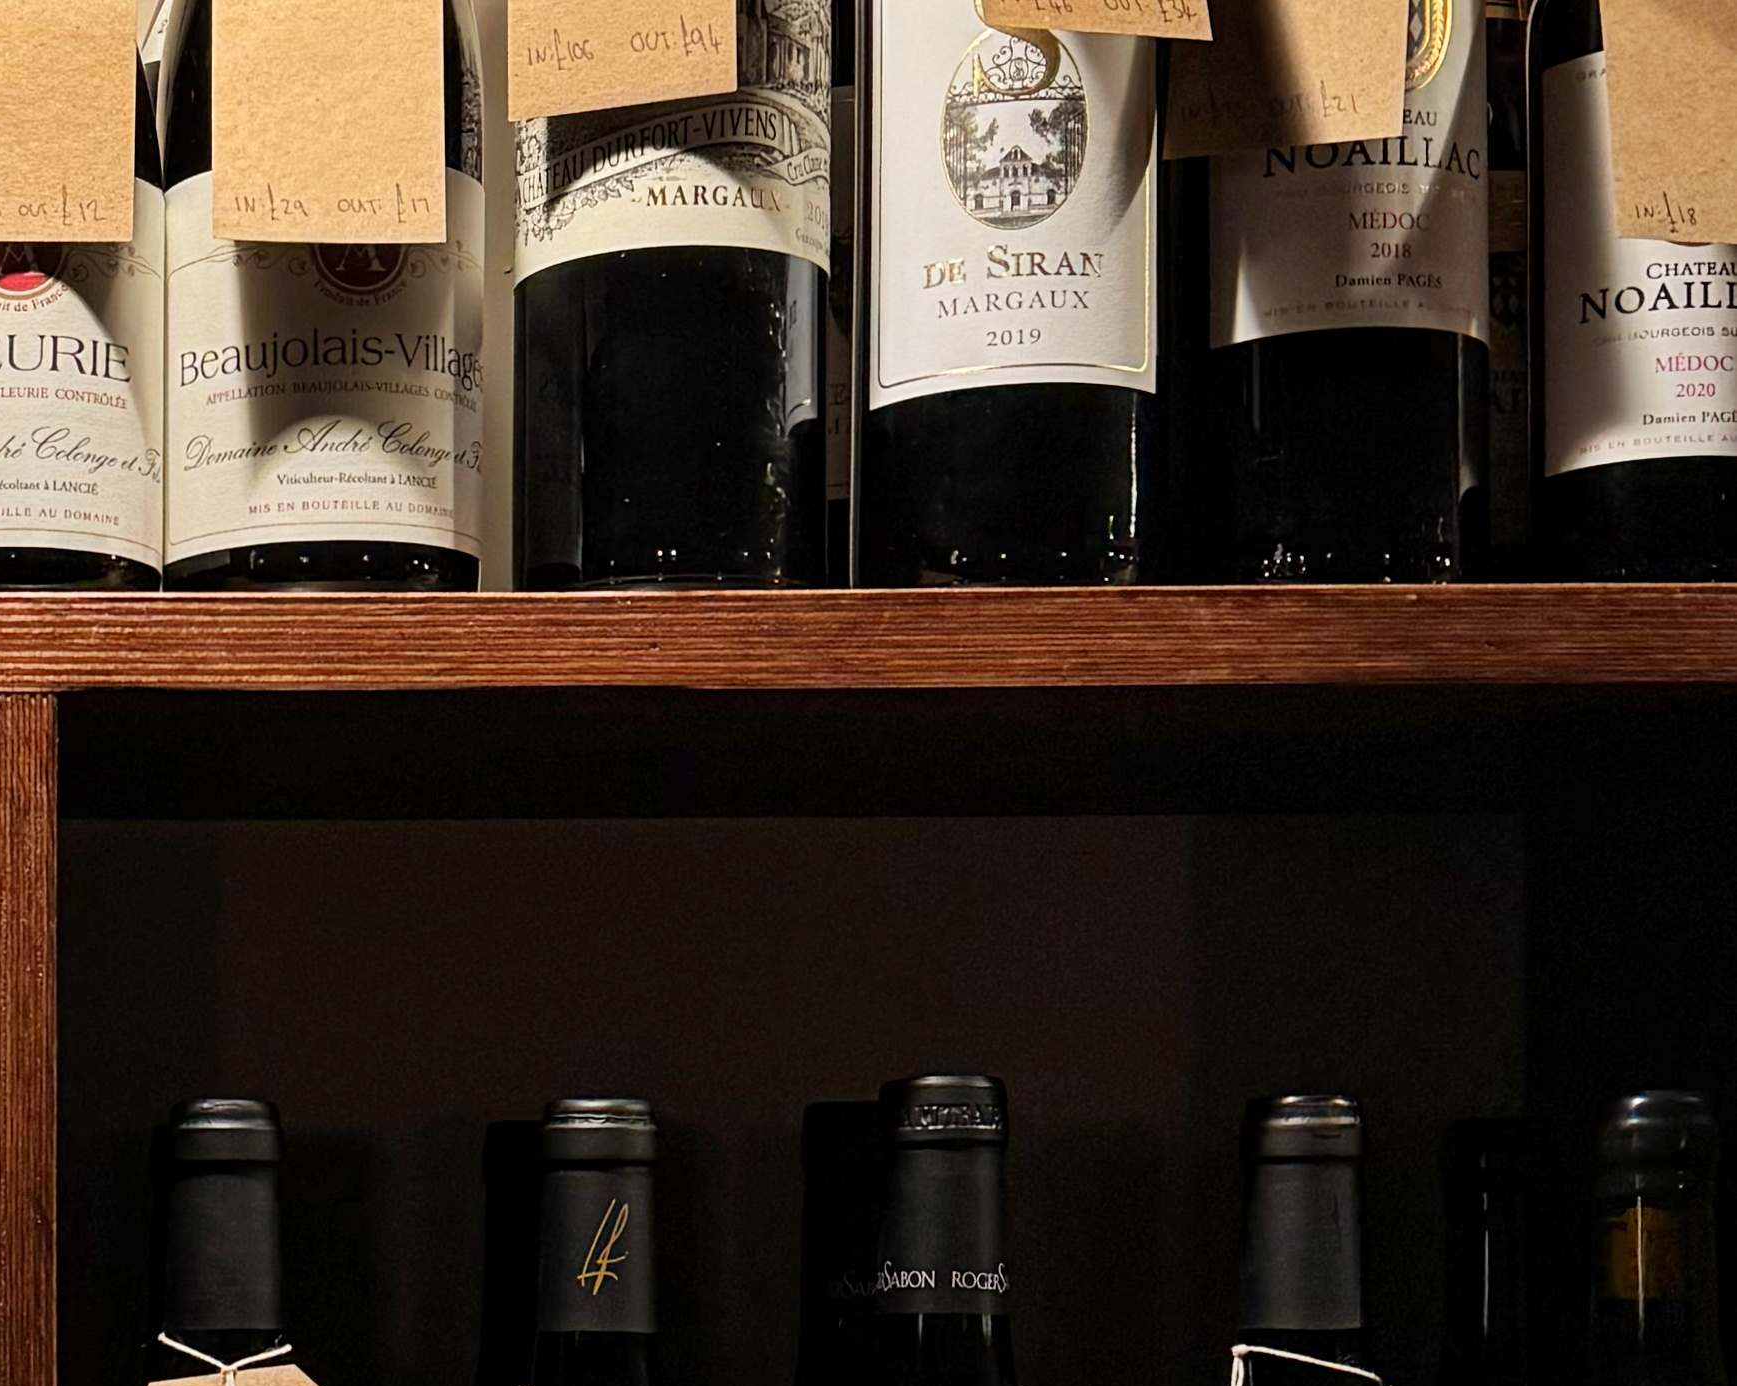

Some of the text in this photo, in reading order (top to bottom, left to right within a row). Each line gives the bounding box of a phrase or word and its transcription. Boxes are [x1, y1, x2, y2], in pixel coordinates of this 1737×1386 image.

[593, 108, 778, 175] DURFORT-VIVENS
[1262, 136, 1482, 180] NOAILLAC
[646, 184, 781, 213] MARGAUX
[1348, 206, 1431, 232] MÉDOC
[1370, 241, 1412, 260] 2018
[923, 244, 1104, 289] DE SIRAN
[1335, 273, 1391, 289] Damien
[32, 283, 70, 311] France
[937, 289, 1091, 320] MARGAUX
[986, 328, 1042, 347] 2019
[1655, 353, 1734, 374] MÉDOC
[54, 387, 129, 410] CONTRÔLÉE
[205, 380, 430, 406] APPELLATION BEAUJOLAIS-VILLAGES
[1675, 381, 1716, 399] 2020
[1642, 411, 1696, 427] Damien
[31, 425, 119, 474] Colonge
[184, 433, 278, 472] Domaine
[283, 419, 371, 455] André
[39, 507, 57, 518] AU
[64, 508, 121, 527] DOMAINE
[248, 500, 403, 515] MIS EN BOUTEILLE AU
